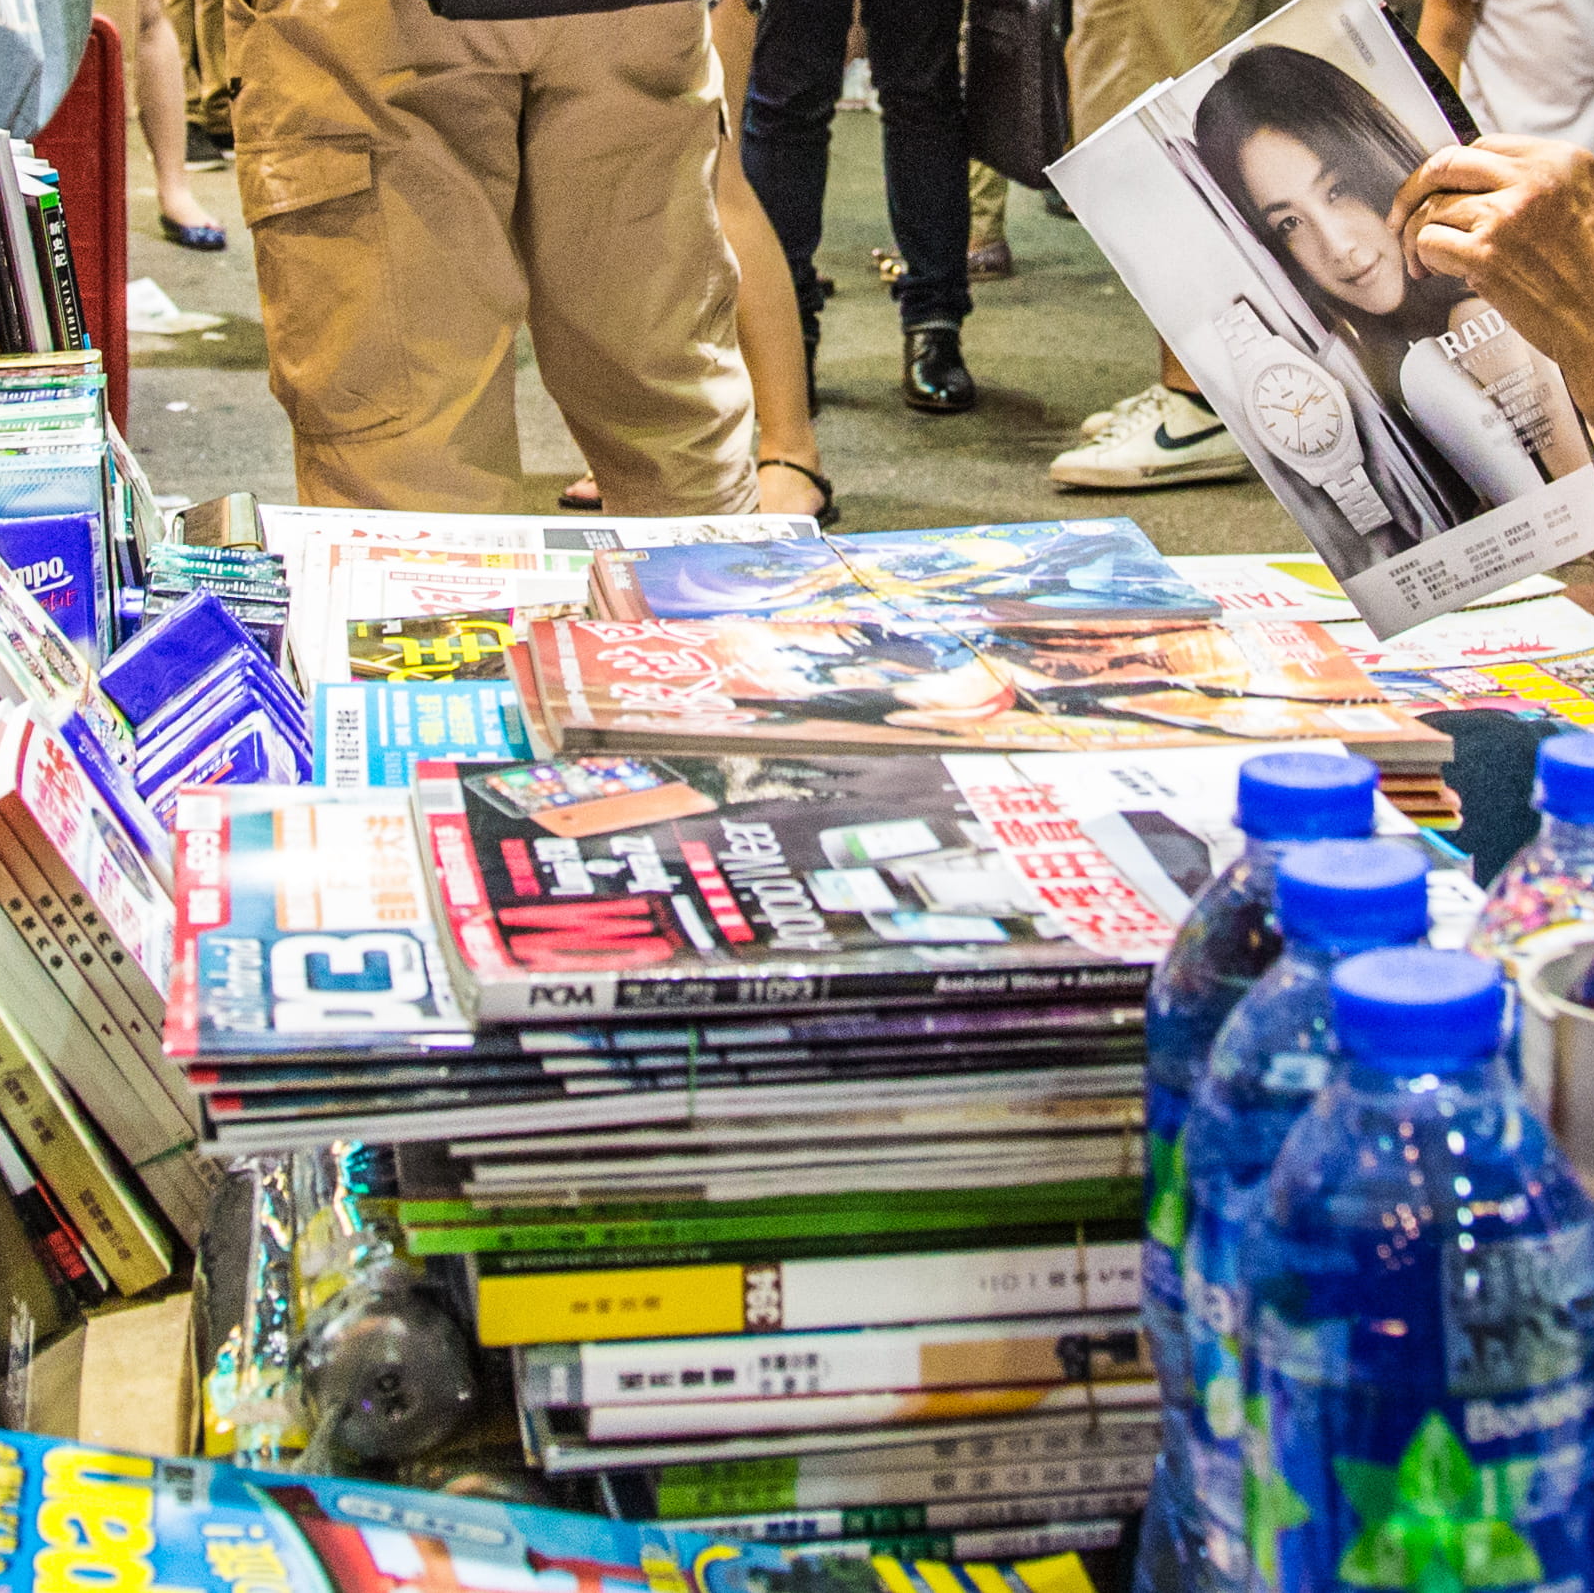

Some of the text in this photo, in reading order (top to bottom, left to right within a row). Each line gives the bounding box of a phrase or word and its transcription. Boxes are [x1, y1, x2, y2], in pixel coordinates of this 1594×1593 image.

[1436, 305, 1508, 362] RAD
[13, 555, 66, 587] mpo
[41, 589, 78, 612] etit
[528, 983, 597, 1007] PCM
